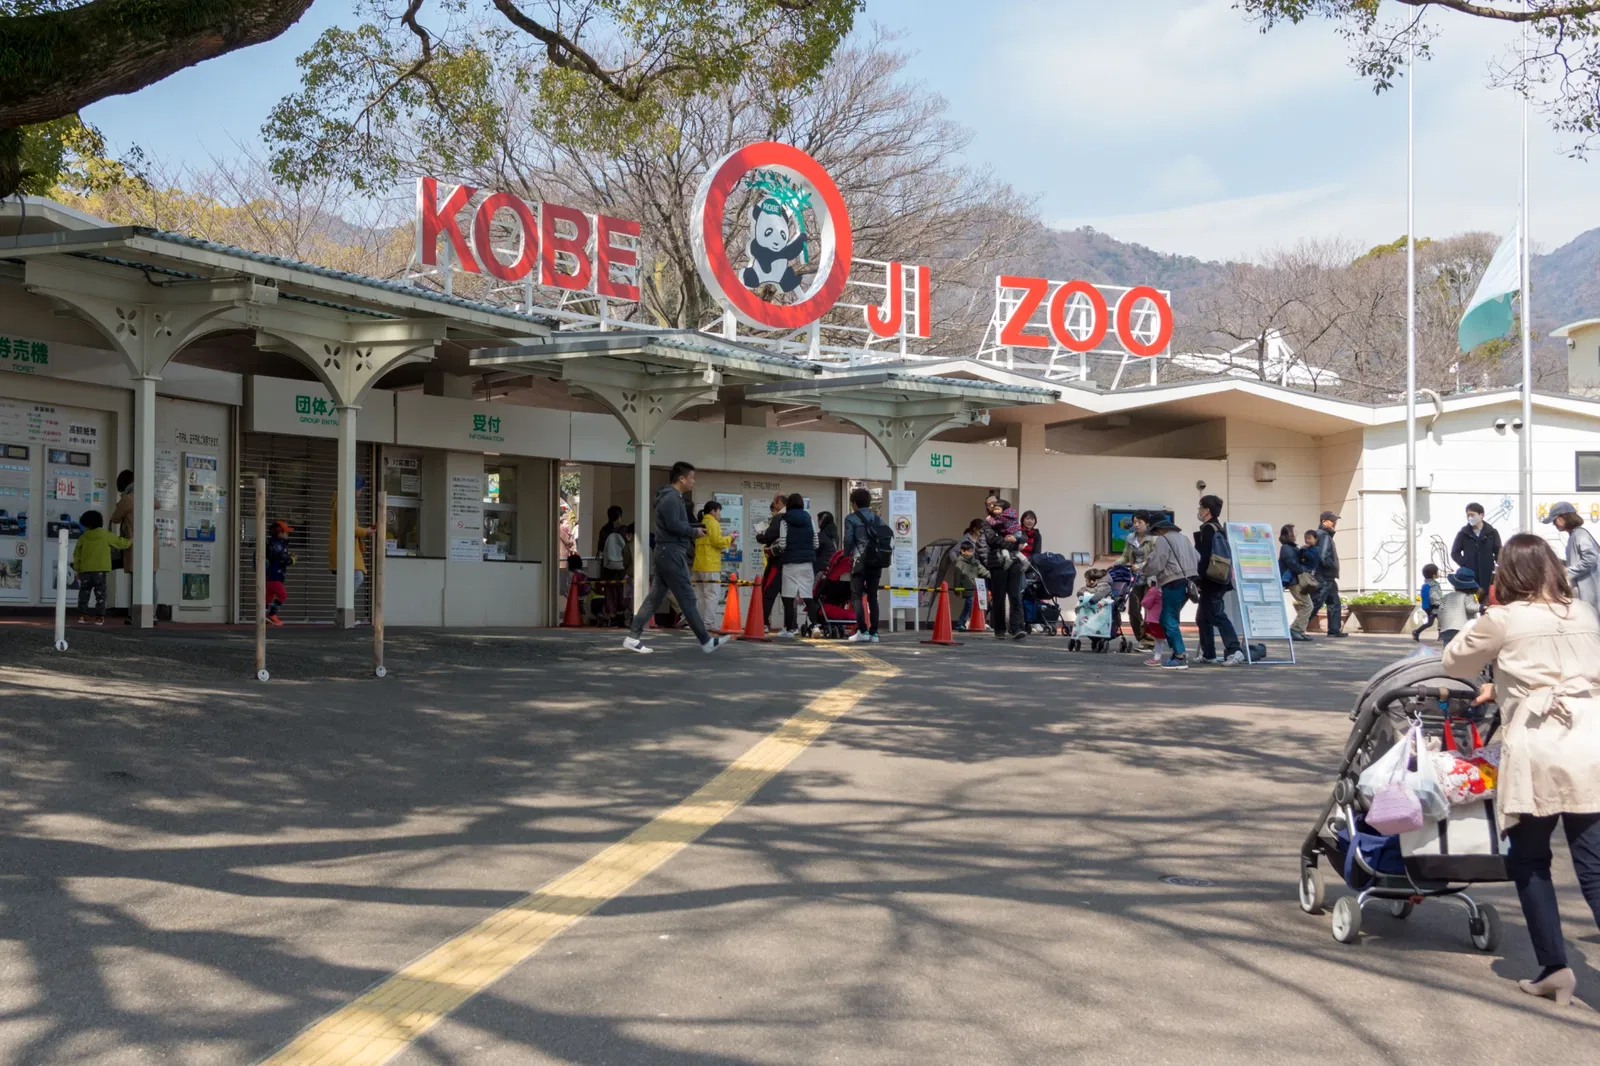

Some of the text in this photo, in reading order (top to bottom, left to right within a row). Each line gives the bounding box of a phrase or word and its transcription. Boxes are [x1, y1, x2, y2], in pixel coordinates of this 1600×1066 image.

[763, 202, 780, 213] KOBE
[416, 177, 641, 302] KOBE
[998, 275, 1174, 359] ZOO
[12, 363, 35, 374] TICKET
[300, 416, 320, 424] GROUP
[473, 414, 501, 434] 受付
[469, 434, 504, 443] INFORMATION
[766, 440, 806, 457] 券売機
[930, 452, 953, 468] 出口
[57, 480, 76, 496] 中止
